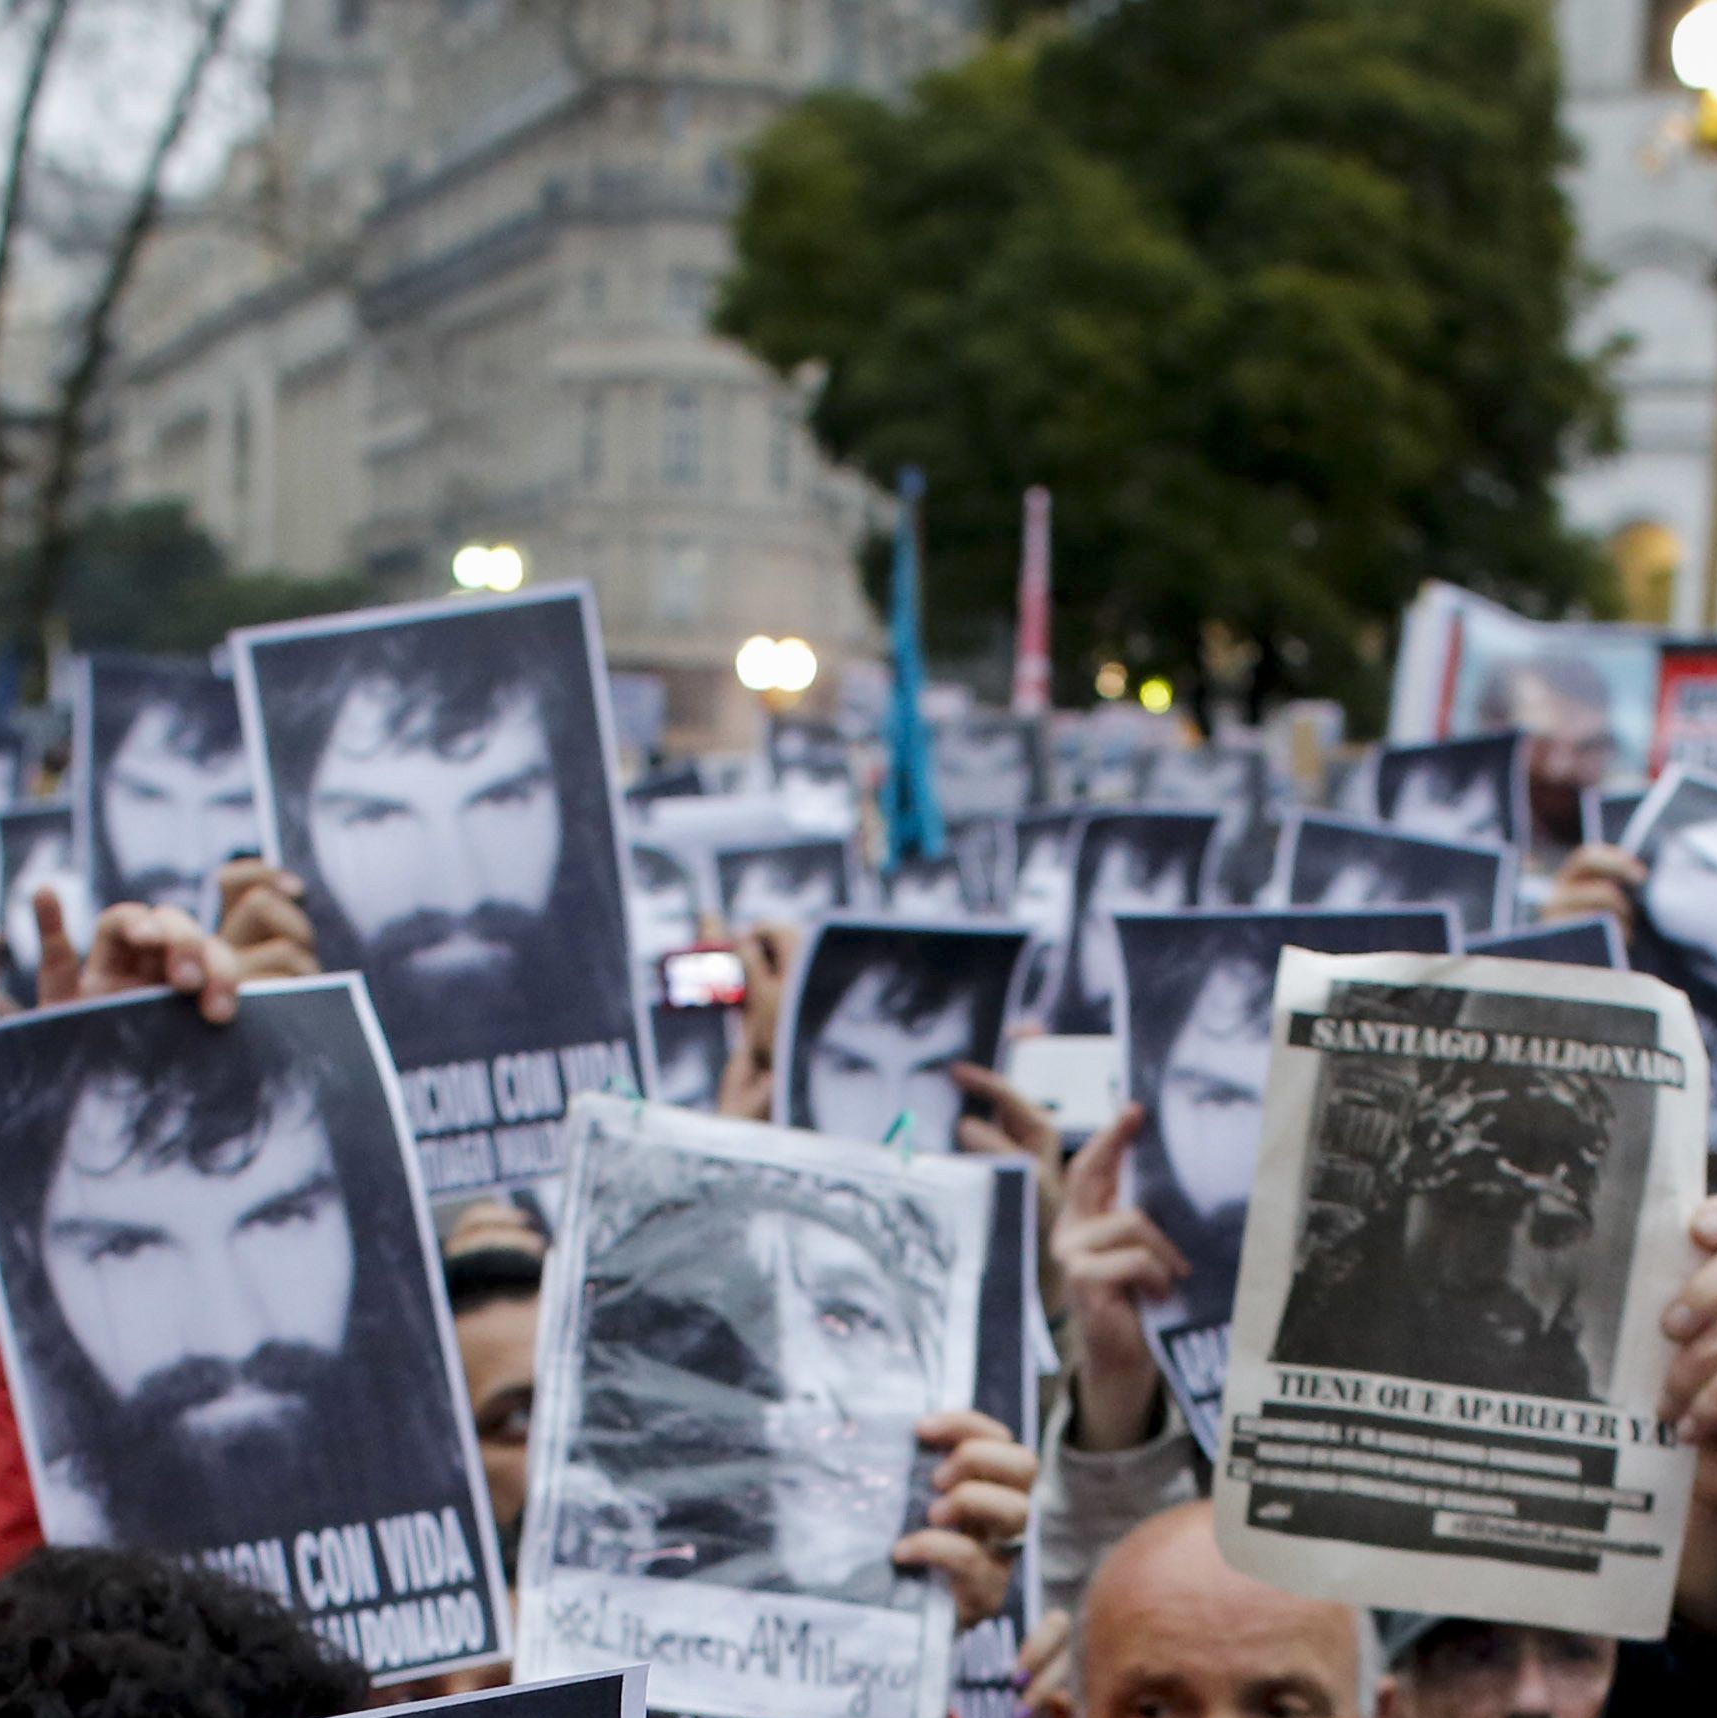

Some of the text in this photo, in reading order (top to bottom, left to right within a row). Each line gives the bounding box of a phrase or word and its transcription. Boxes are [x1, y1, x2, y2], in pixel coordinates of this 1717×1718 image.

[1311, 1016, 1489, 1062] SANTIAGO
[1281, 1372, 1368, 1403] TIENE
[1378, 1381, 1444, 1413] QUE
[1450, 1393, 1619, 1440] APARECER
[294, 1522, 380, 1611] CON
[376, 1506, 474, 1595] VIDA
